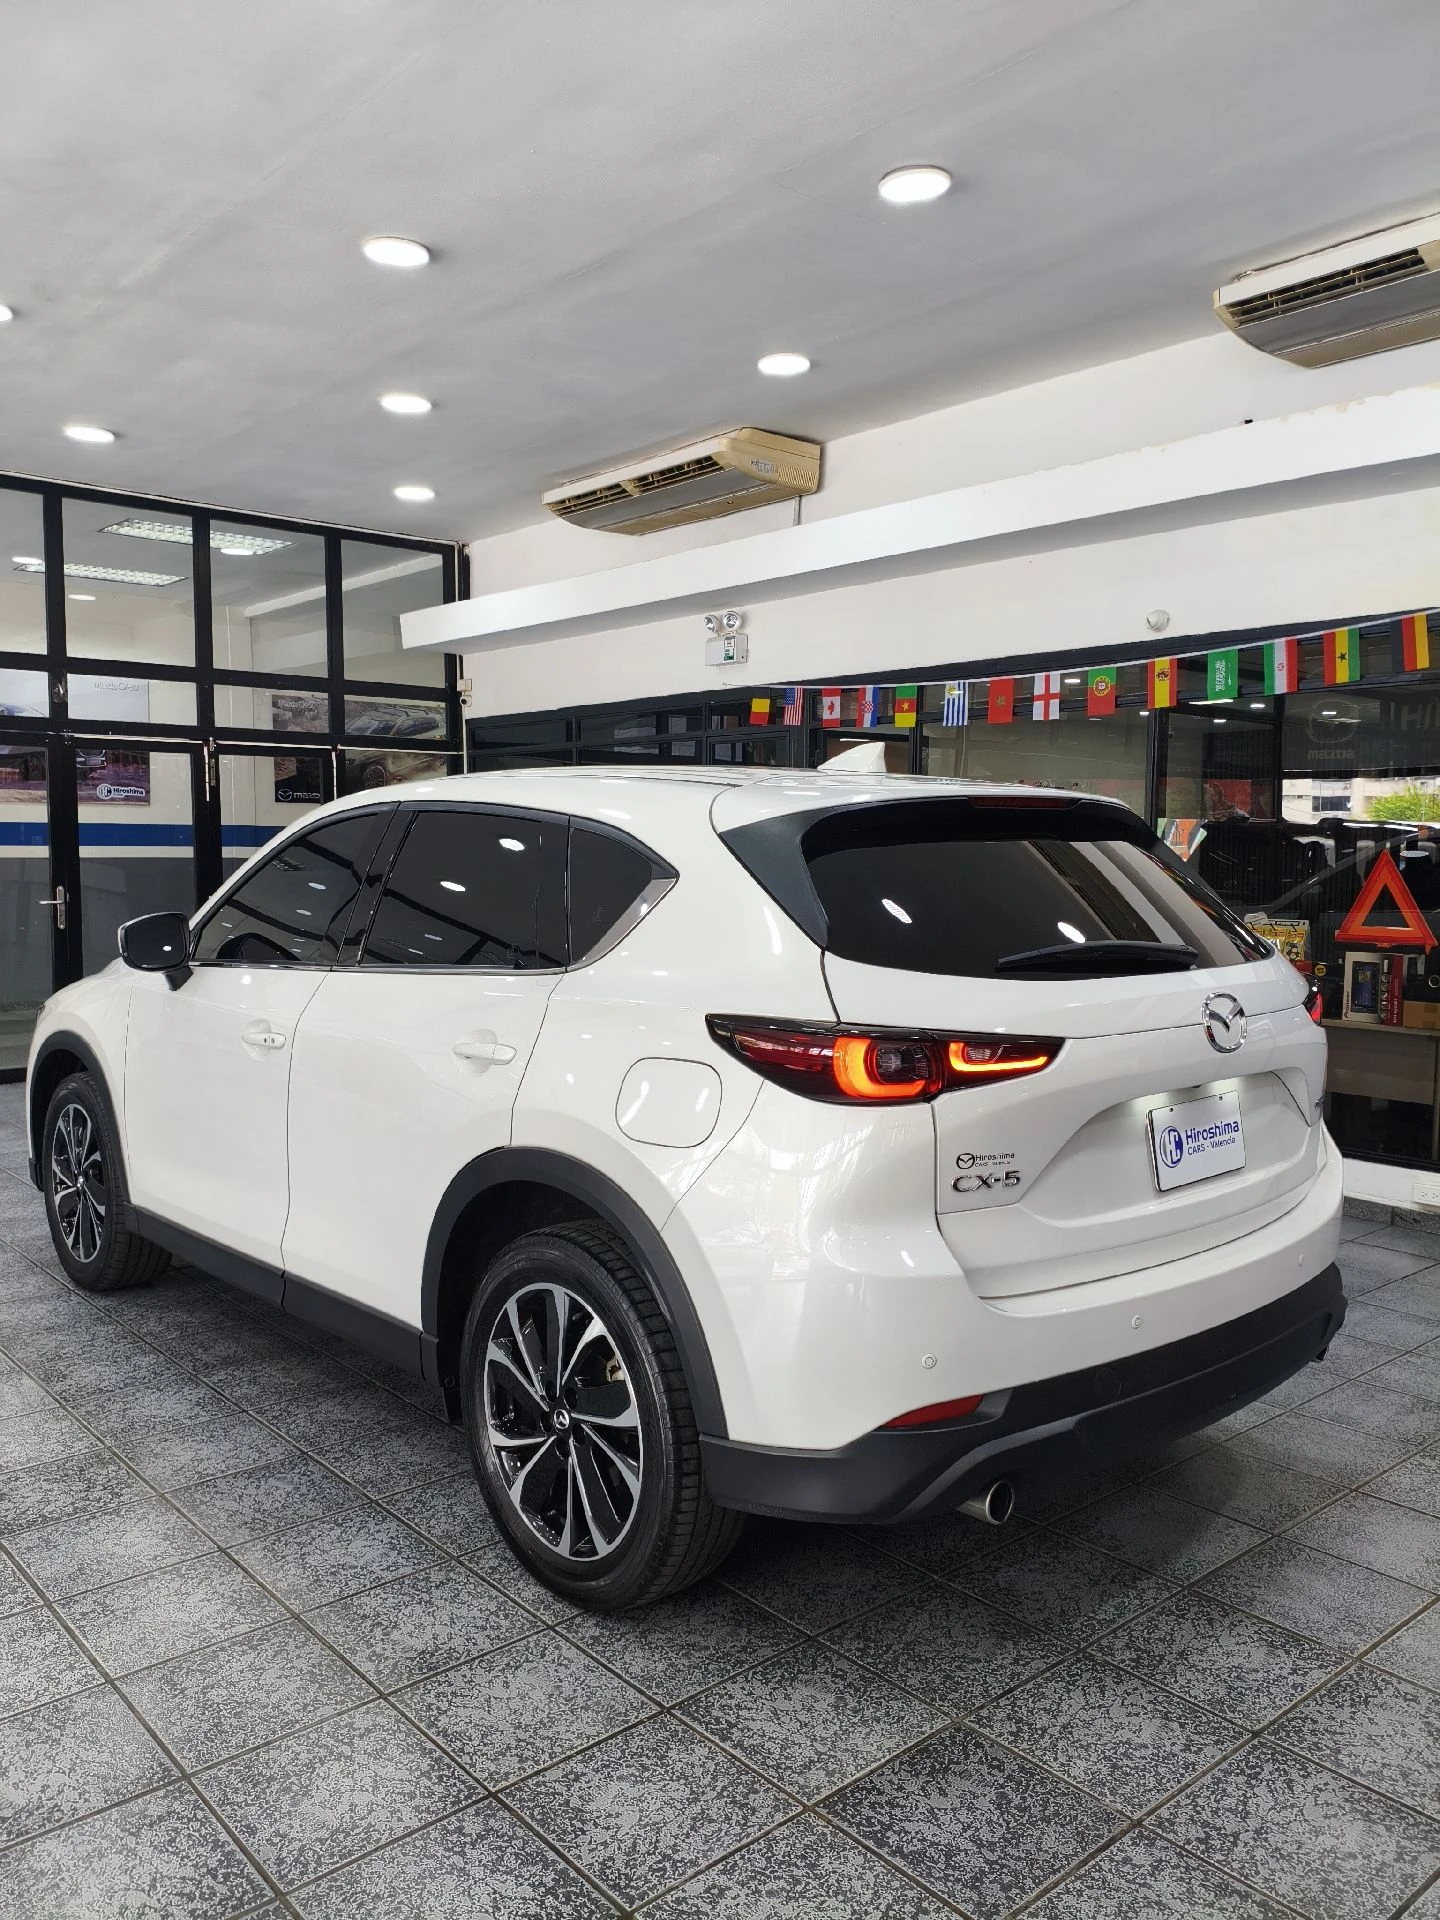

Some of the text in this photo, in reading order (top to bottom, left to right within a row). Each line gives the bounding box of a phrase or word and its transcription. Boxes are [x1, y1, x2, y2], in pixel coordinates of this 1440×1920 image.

[112, 787, 144, 795] Hiroshima
[1185, 1121, 1240, 1145] Hiroshima
[1187, 1144, 1206, 1155] CARS
[1210, 1136, 1236, 1149] Valencia
[975, 1152, 1015, 1162] Hiroshima
[951, 1170, 1021, 1192] CX-5
